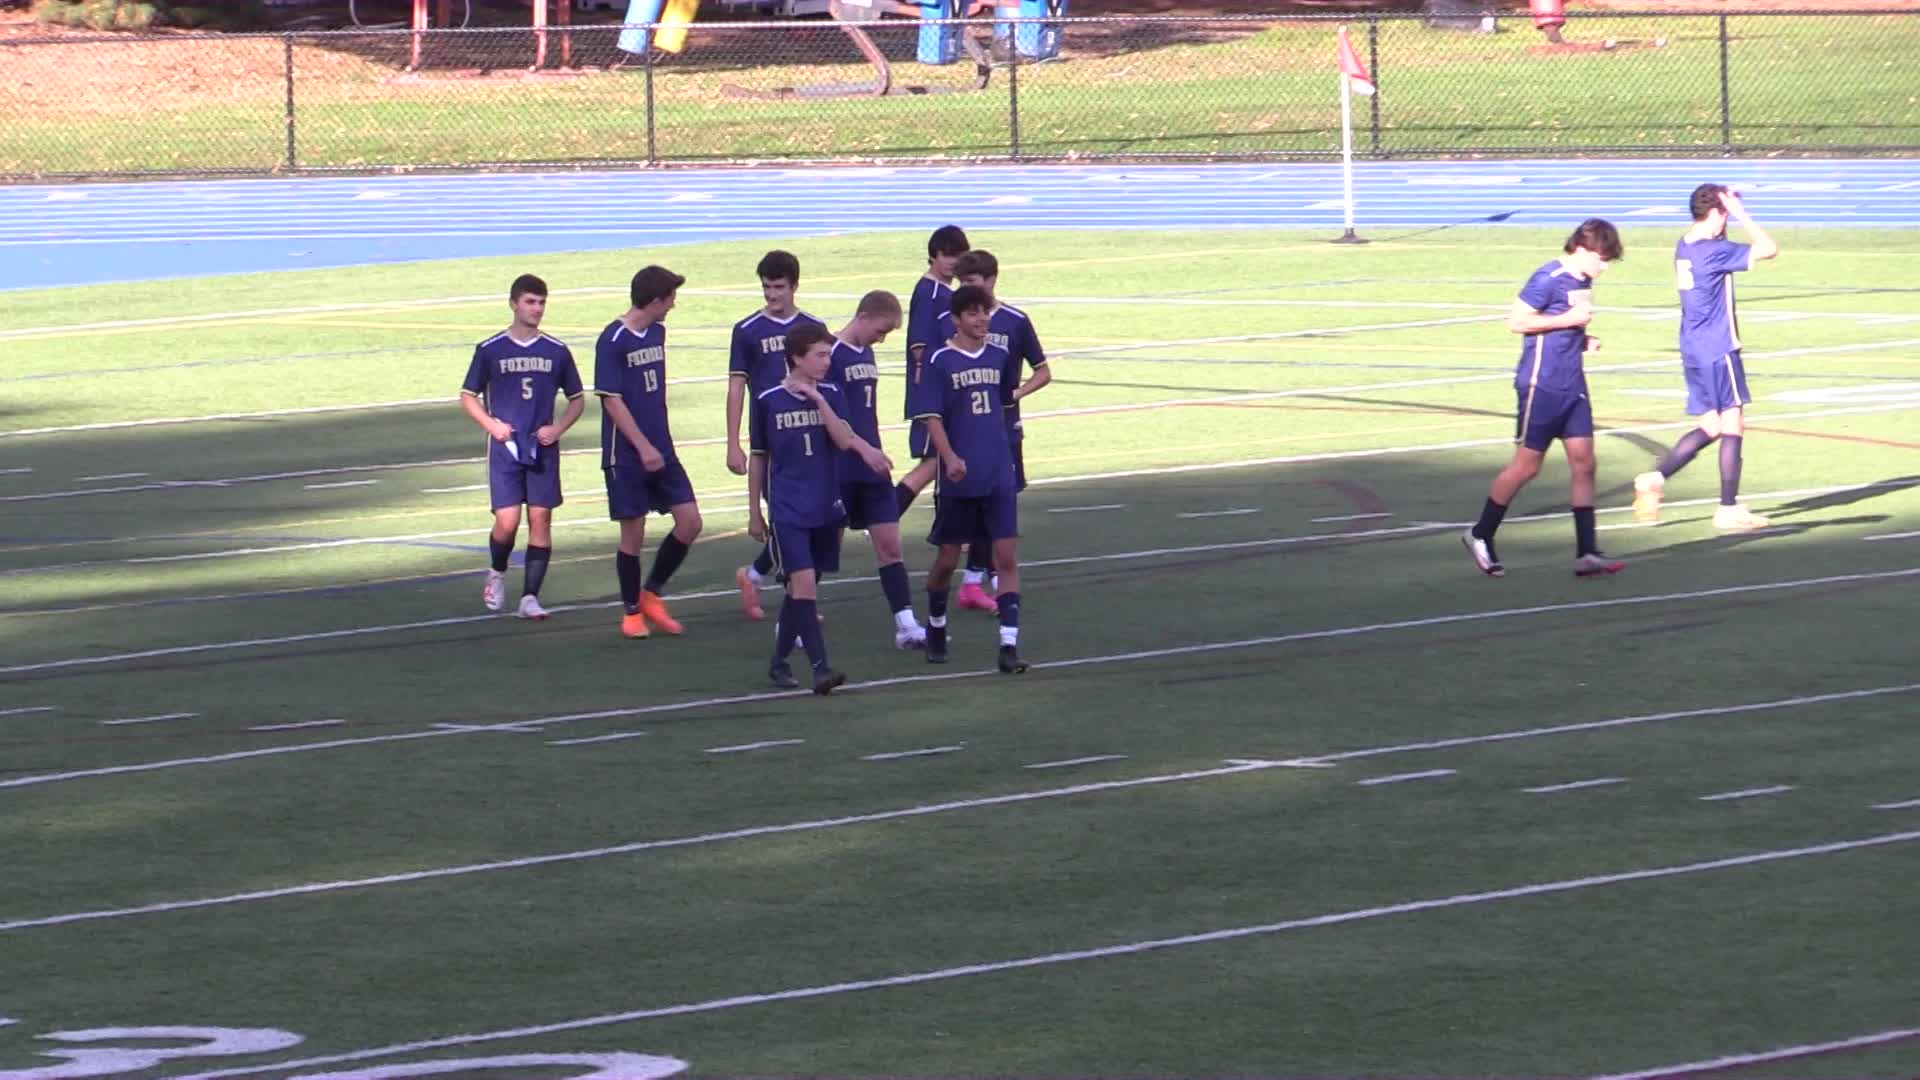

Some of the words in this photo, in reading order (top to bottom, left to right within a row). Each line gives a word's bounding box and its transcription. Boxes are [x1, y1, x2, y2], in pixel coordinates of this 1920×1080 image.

[499, 357, 552, 374] FOXBORO
[521, 377, 533, 400] 5
[643, 370, 658, 393] 19
[951, 368, 1001, 390] FOXBORO
[971, 390, 992, 414] 21
[776, 409, 824, 430] FOXBO
[803, 433, 813, 455] 1
